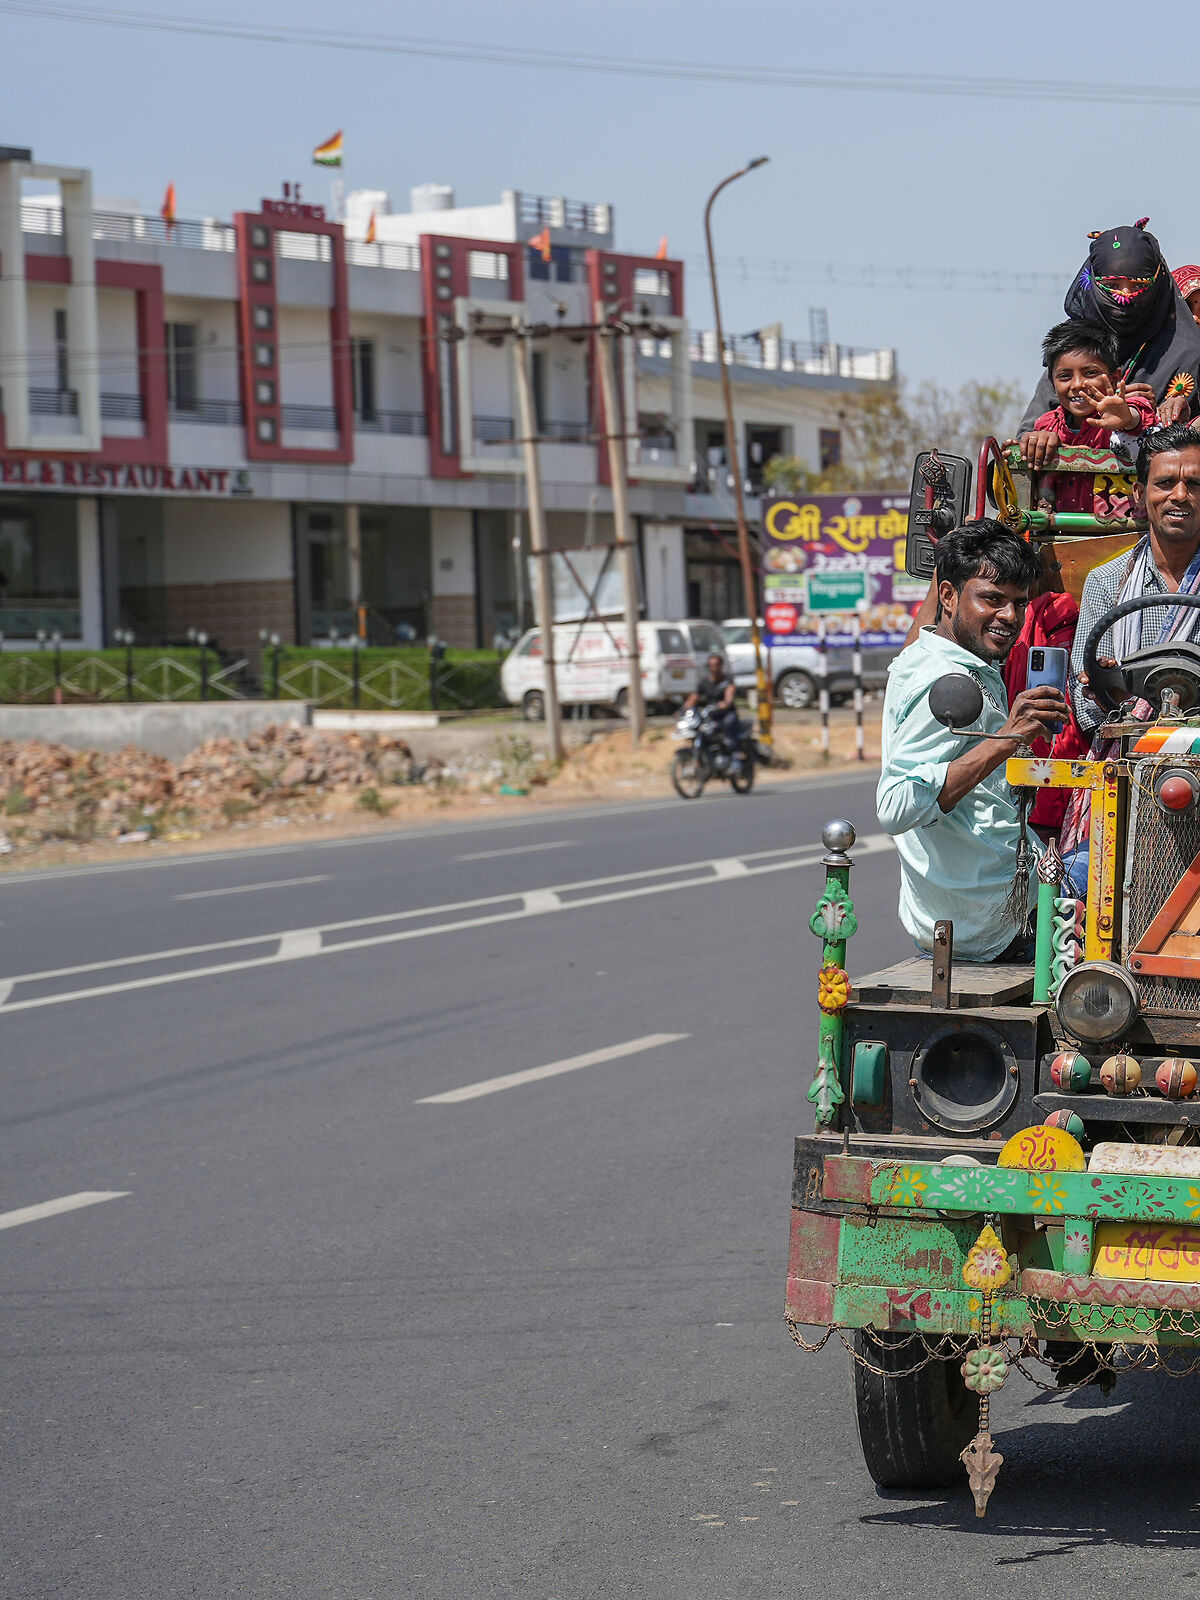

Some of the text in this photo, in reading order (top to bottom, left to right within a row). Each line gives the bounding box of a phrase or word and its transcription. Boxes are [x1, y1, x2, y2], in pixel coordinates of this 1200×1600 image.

[63, 462, 229, 493] RESTAURANT
[765, 501, 821, 541] श्री
[1104, 1230, 1167, 1269] जय
